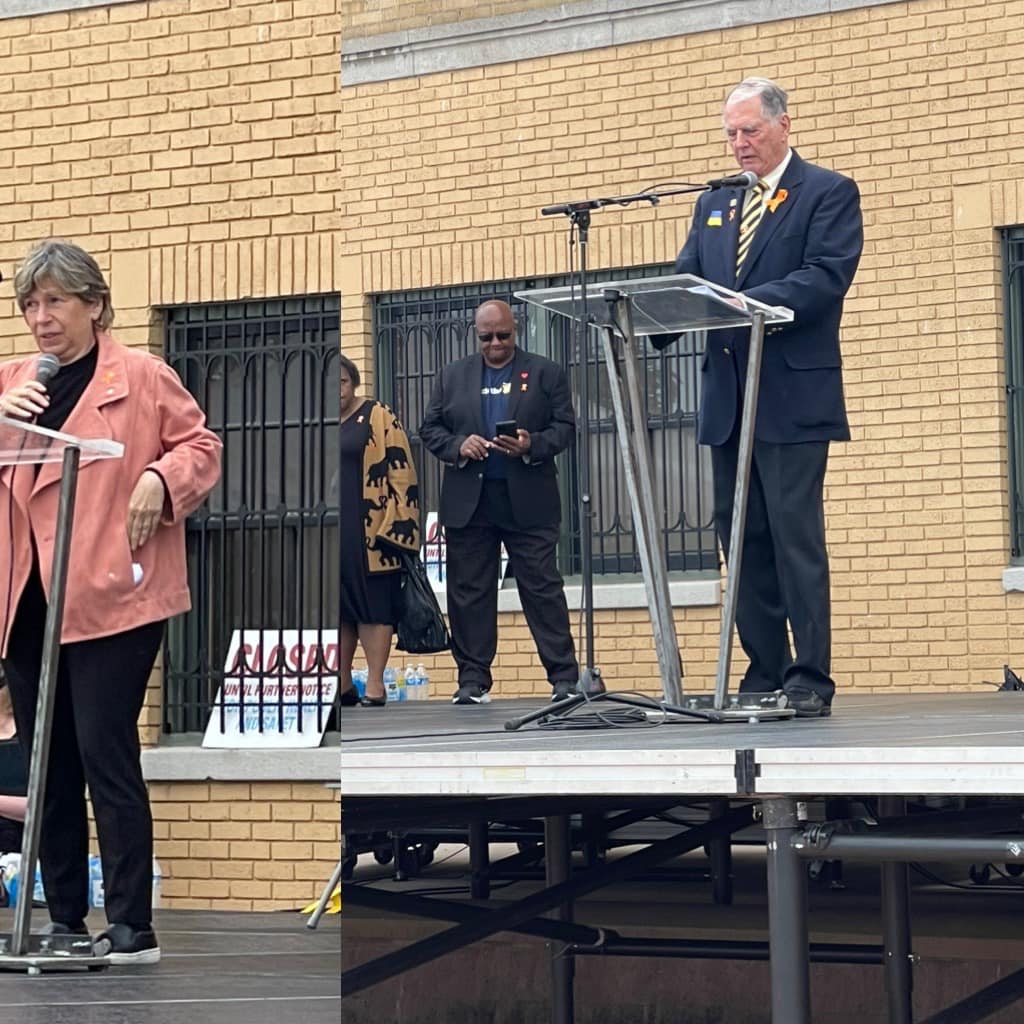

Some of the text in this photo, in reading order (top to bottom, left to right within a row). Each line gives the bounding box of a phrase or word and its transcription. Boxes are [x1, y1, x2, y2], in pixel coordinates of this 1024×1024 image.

[224, 683, 332, 697] UNIL FURTER OTCE
